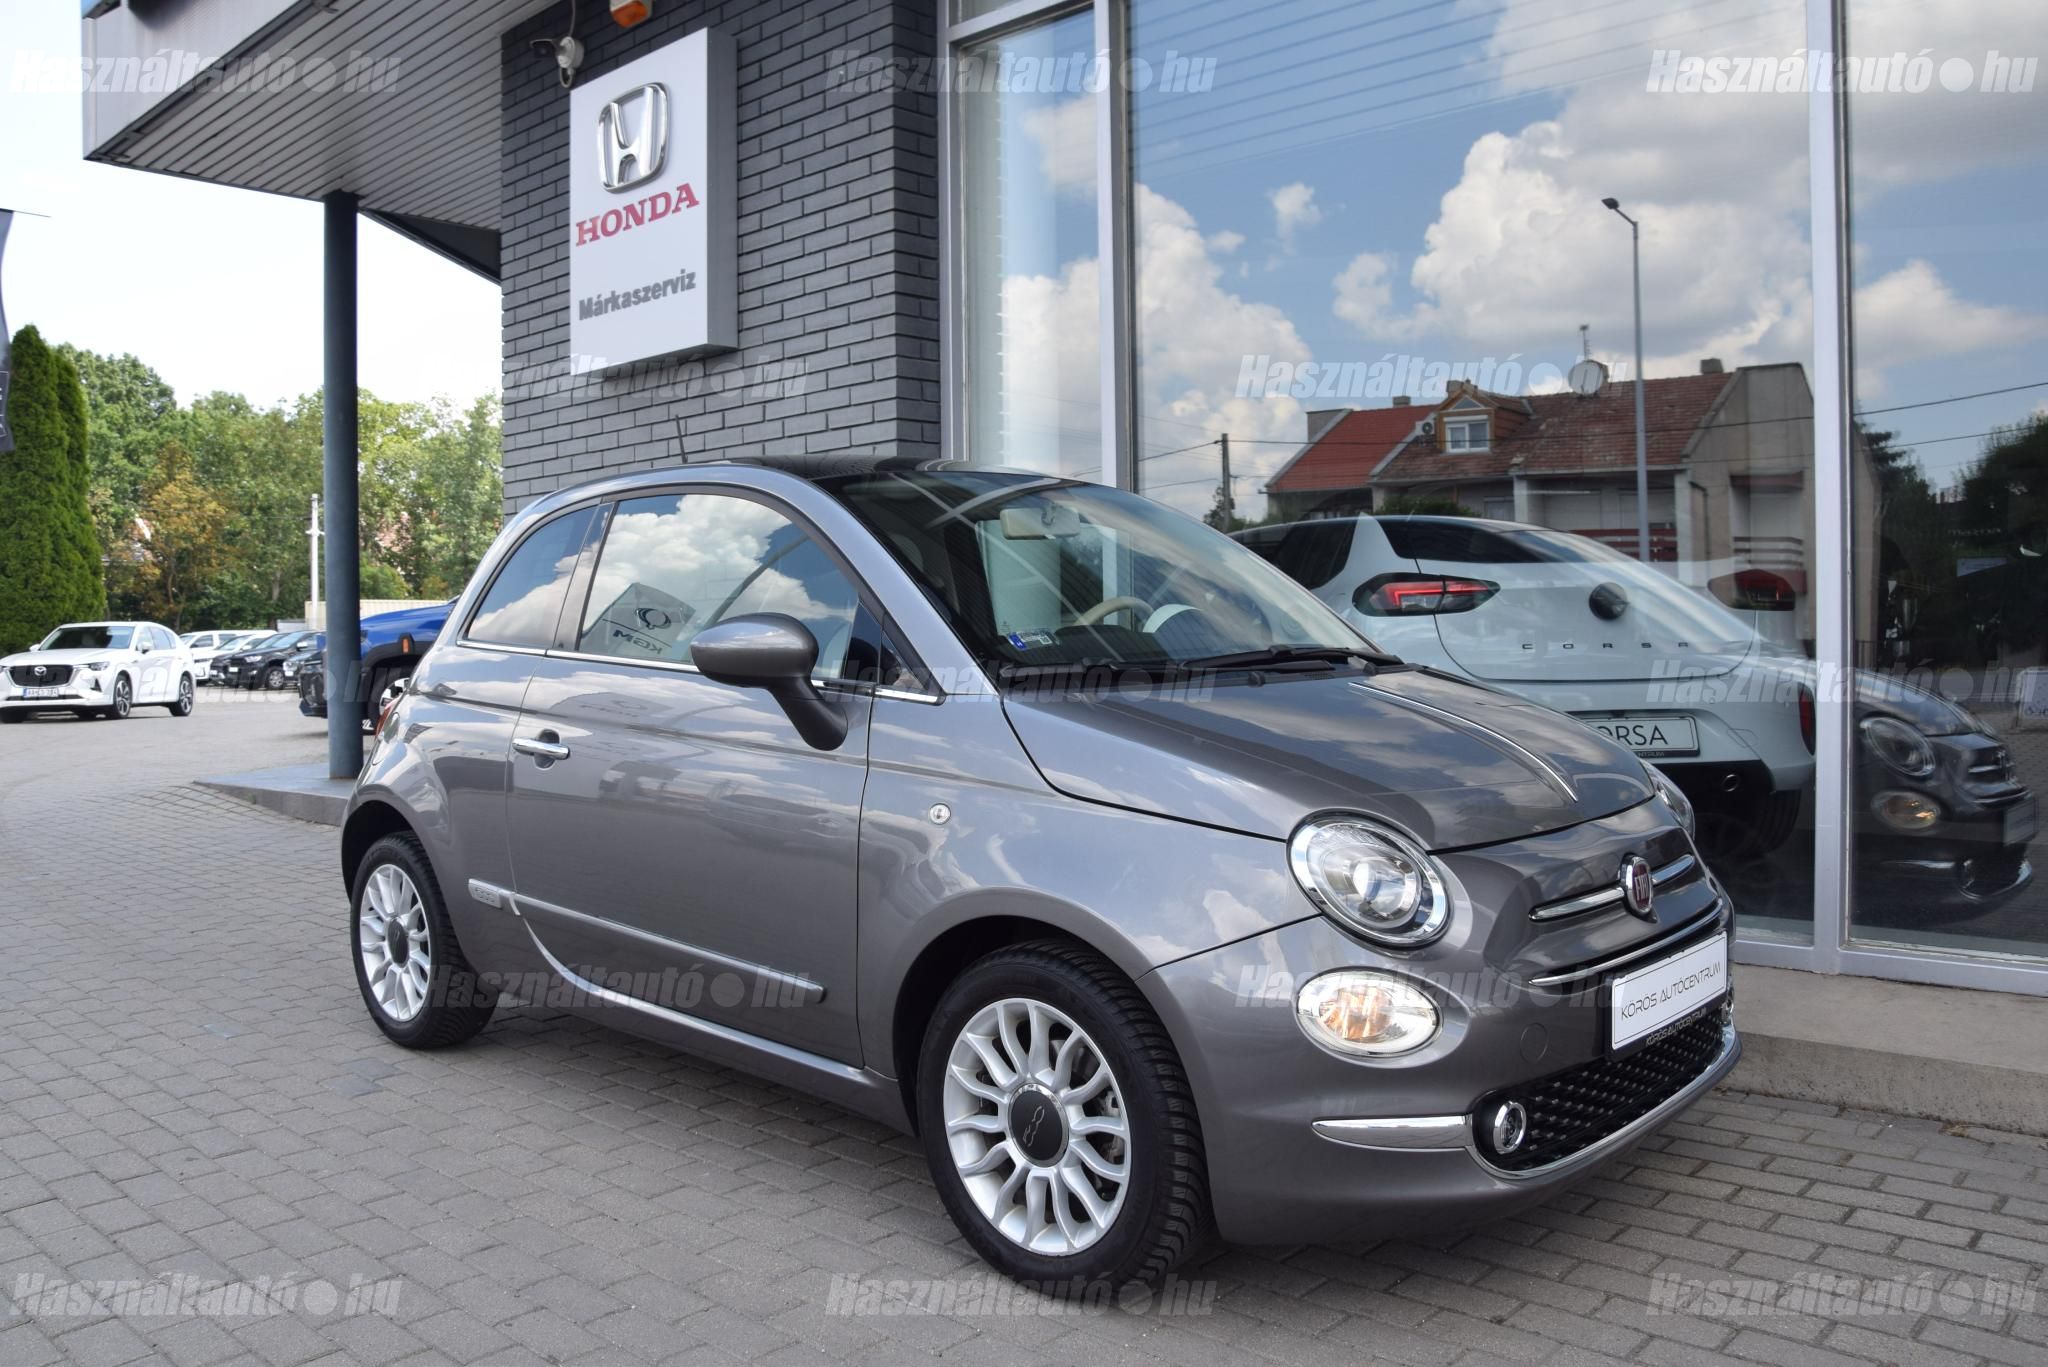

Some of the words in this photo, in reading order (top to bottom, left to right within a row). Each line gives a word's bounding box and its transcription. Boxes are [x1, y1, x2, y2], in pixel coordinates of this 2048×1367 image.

[576, 183, 699, 246] HONDA
[579, 269, 696, 321] Márkaszerviz
[1522, 642, 1689, 650] CORSA
[1660, 961, 1721, 1003] AUTÓCENTRUM
